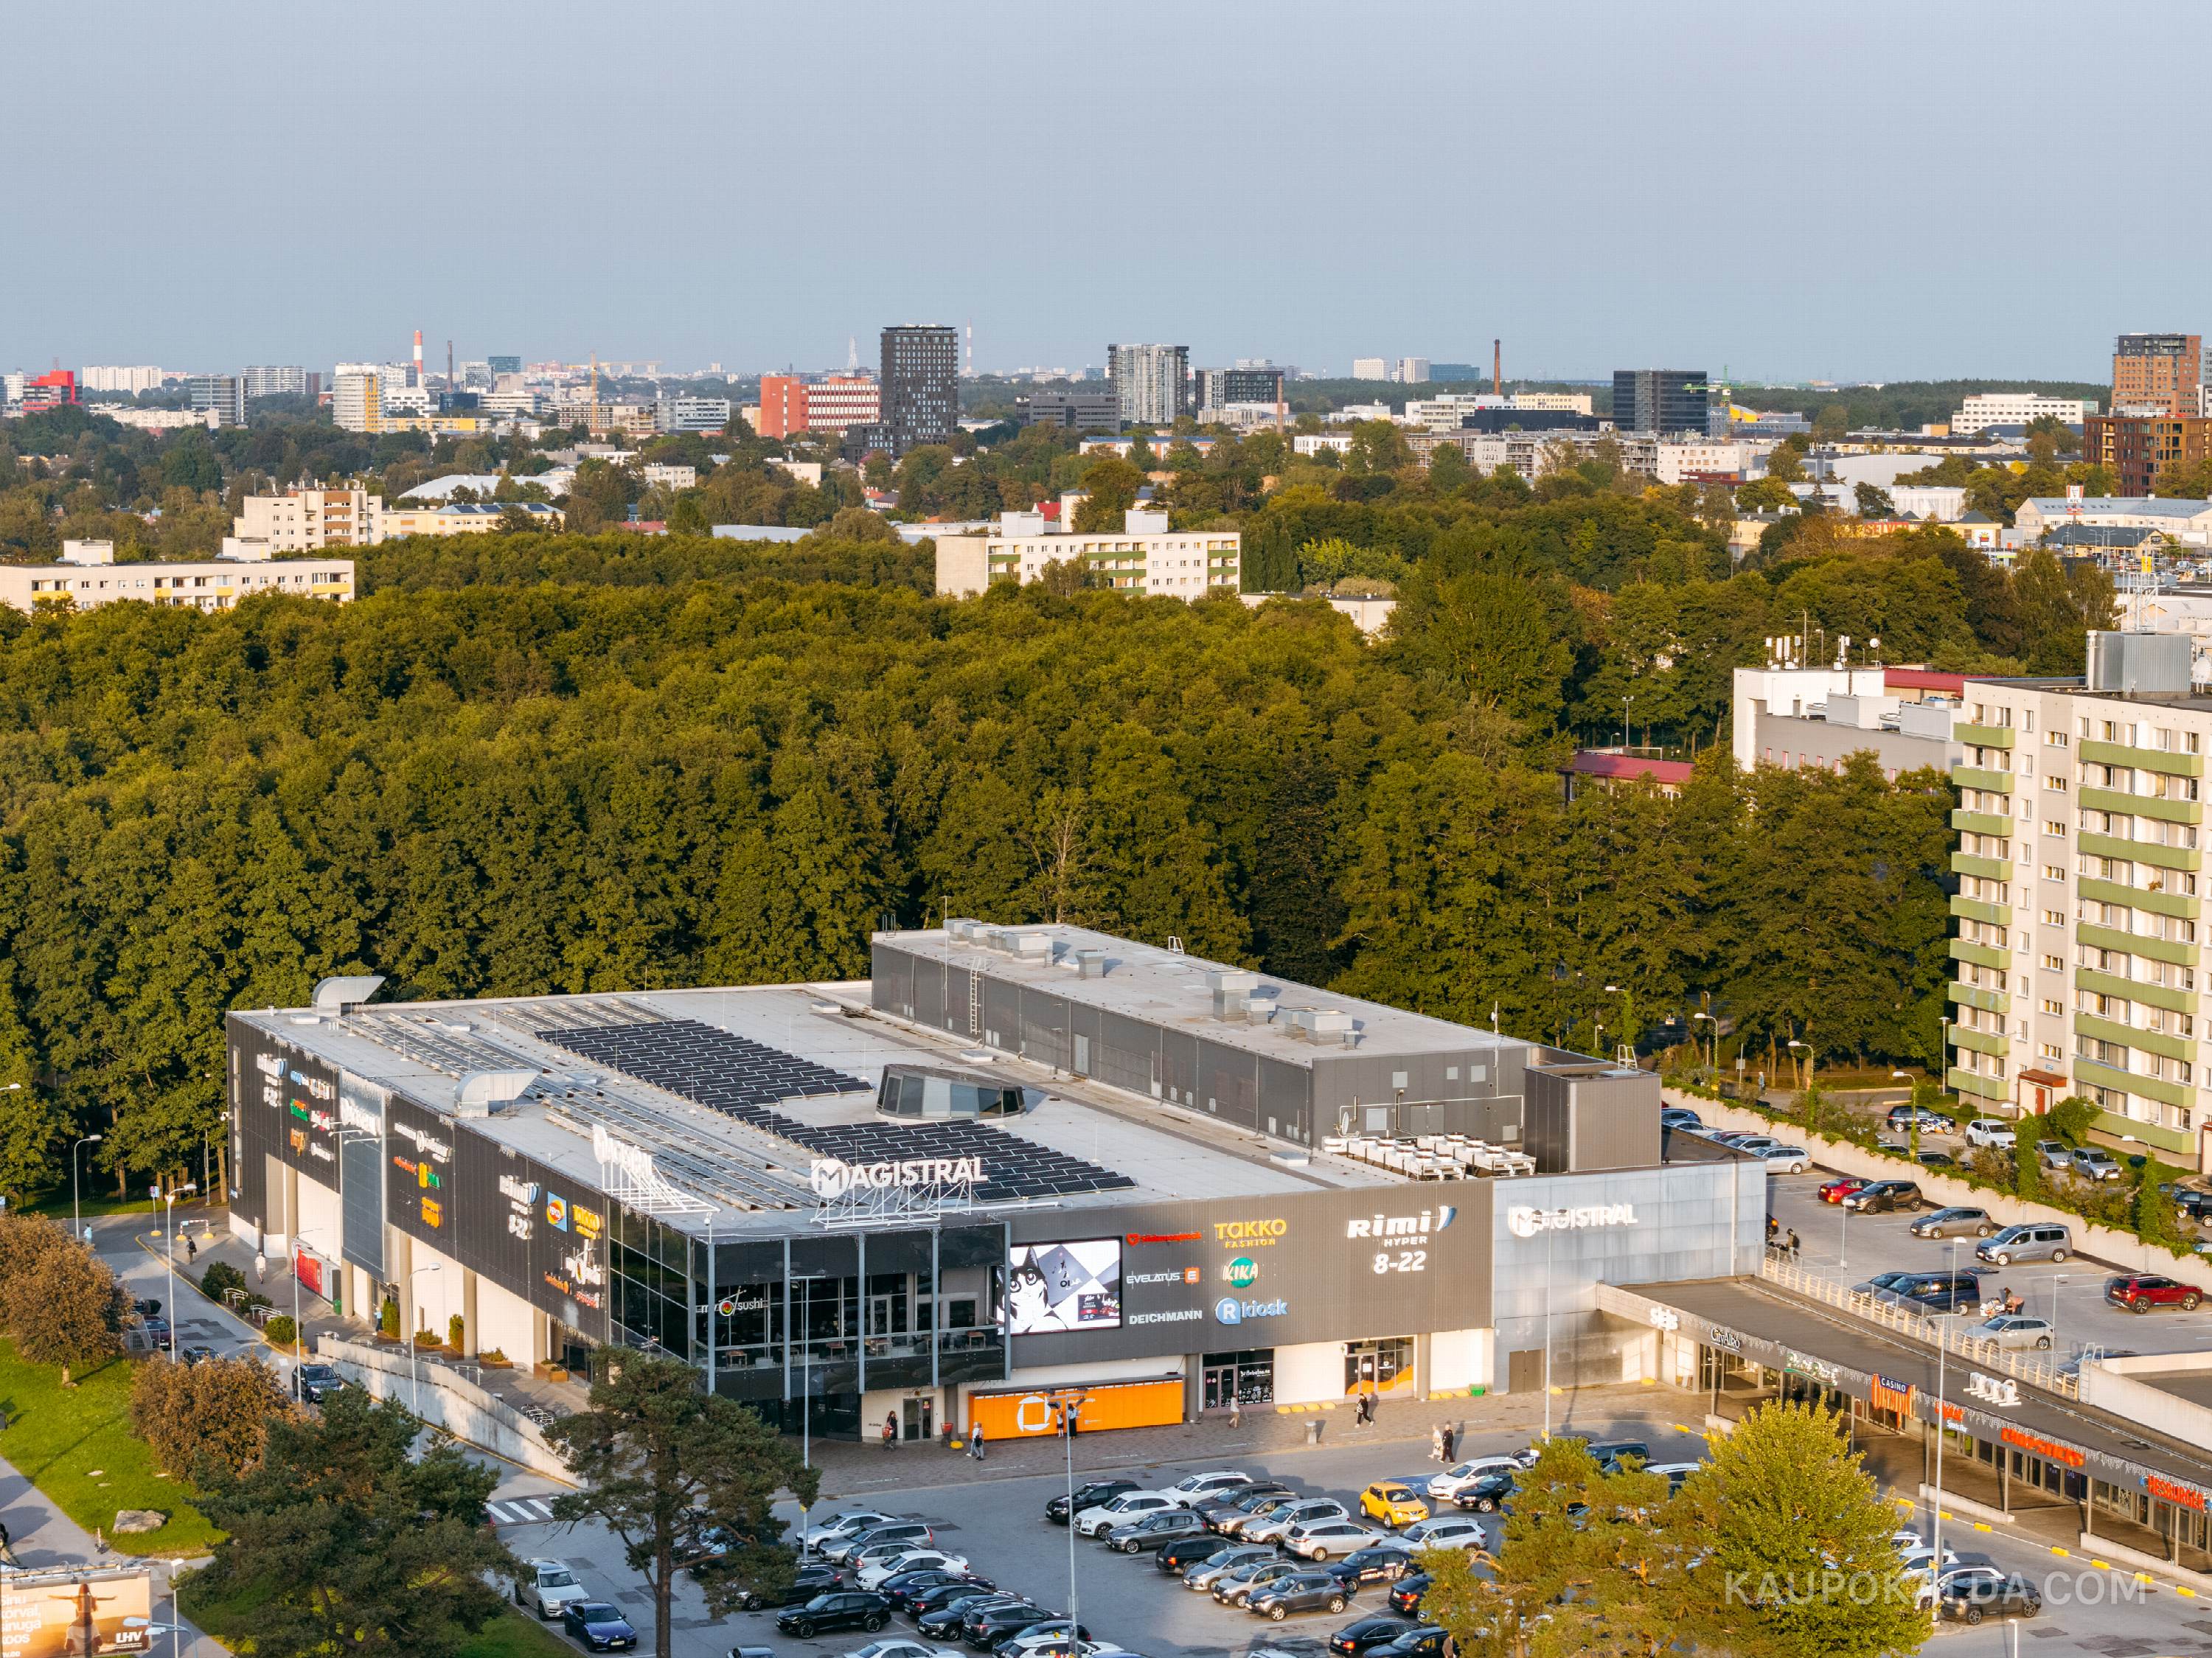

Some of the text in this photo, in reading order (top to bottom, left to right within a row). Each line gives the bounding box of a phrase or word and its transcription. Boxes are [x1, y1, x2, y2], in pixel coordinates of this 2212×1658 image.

[811, 1157, 988, 1198] MAGISTRAL
[1346, 1210, 1432, 1238] Rimi
[1225, 1239, 1276, 1248] FASHION
[1384, 1236, 1427, 1247] HYPER
[1373, 1250, 1427, 1274] 8-22
[1127, 1272, 1180, 1284] EVELATUS
[1222, 1263, 1259, 1281] KIKA
[737, 1297, 764, 1311] sushi
[1242, 1298, 1289, 1317] kiosk
[1129, 1310, 1203, 1325] DEICHMANN
[1881, 1377, 1907, 1393] CASINO
[2147, 1474, 2205, 1512] HESBURGER
[116, 1631, 143, 1643] LHV
